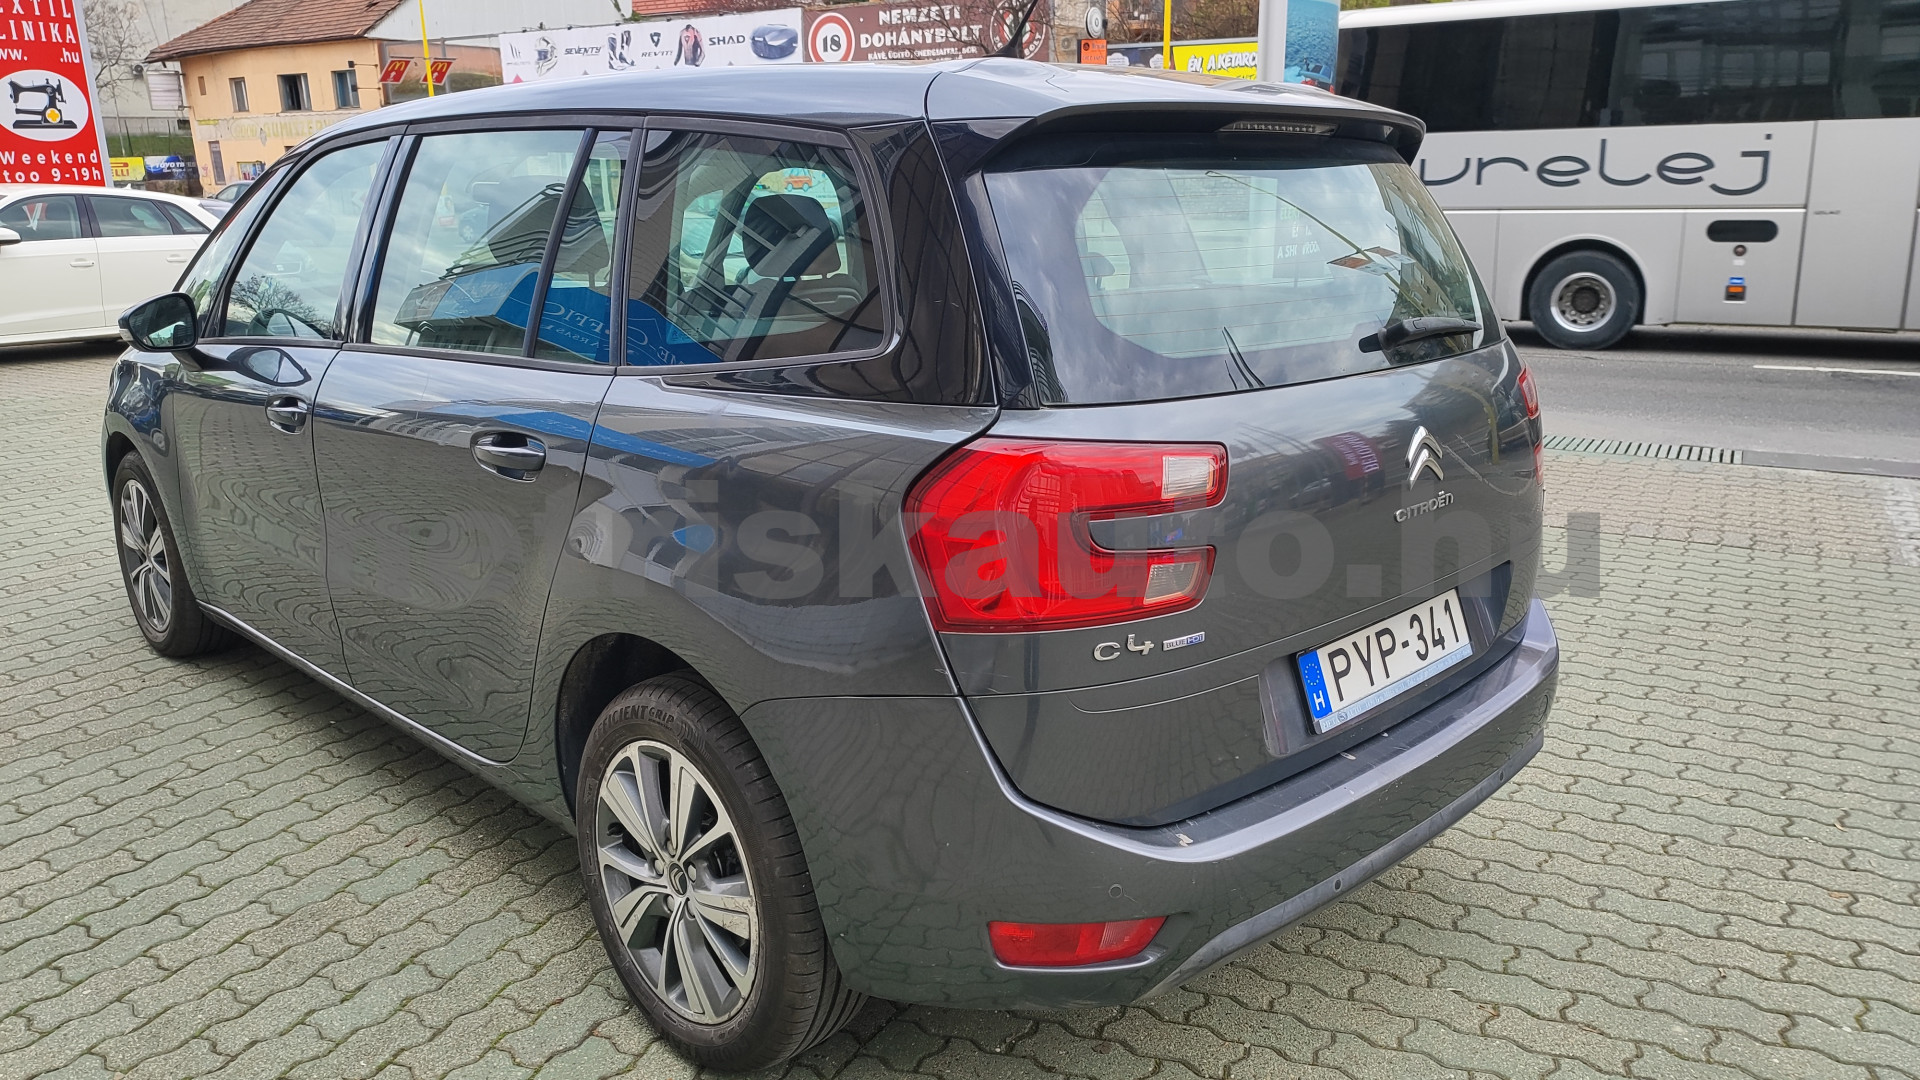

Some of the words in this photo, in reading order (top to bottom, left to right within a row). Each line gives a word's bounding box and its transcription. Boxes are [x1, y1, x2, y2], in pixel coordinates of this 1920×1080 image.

[0, 0, 72, 18] XTIL
[878, 5, 961, 25] NEMZETI
[708, 34, 746, 46] SHAD
[822, 34, 842, 53] 18
[859, 24, 983, 48] DOHÁNYBOLT
[564, 44, 602, 57] SEVENTY
[1206, 54, 1217, 72] A
[1, 150, 98, 165] Weekend
[3, 169, 40, 183] too
[51, 166, 101, 182] 9-19h
[1093, 633, 1155, 661] C4
[1327, 598, 1460, 702] PYP-341
[1312, 689, 1326, 712] H
